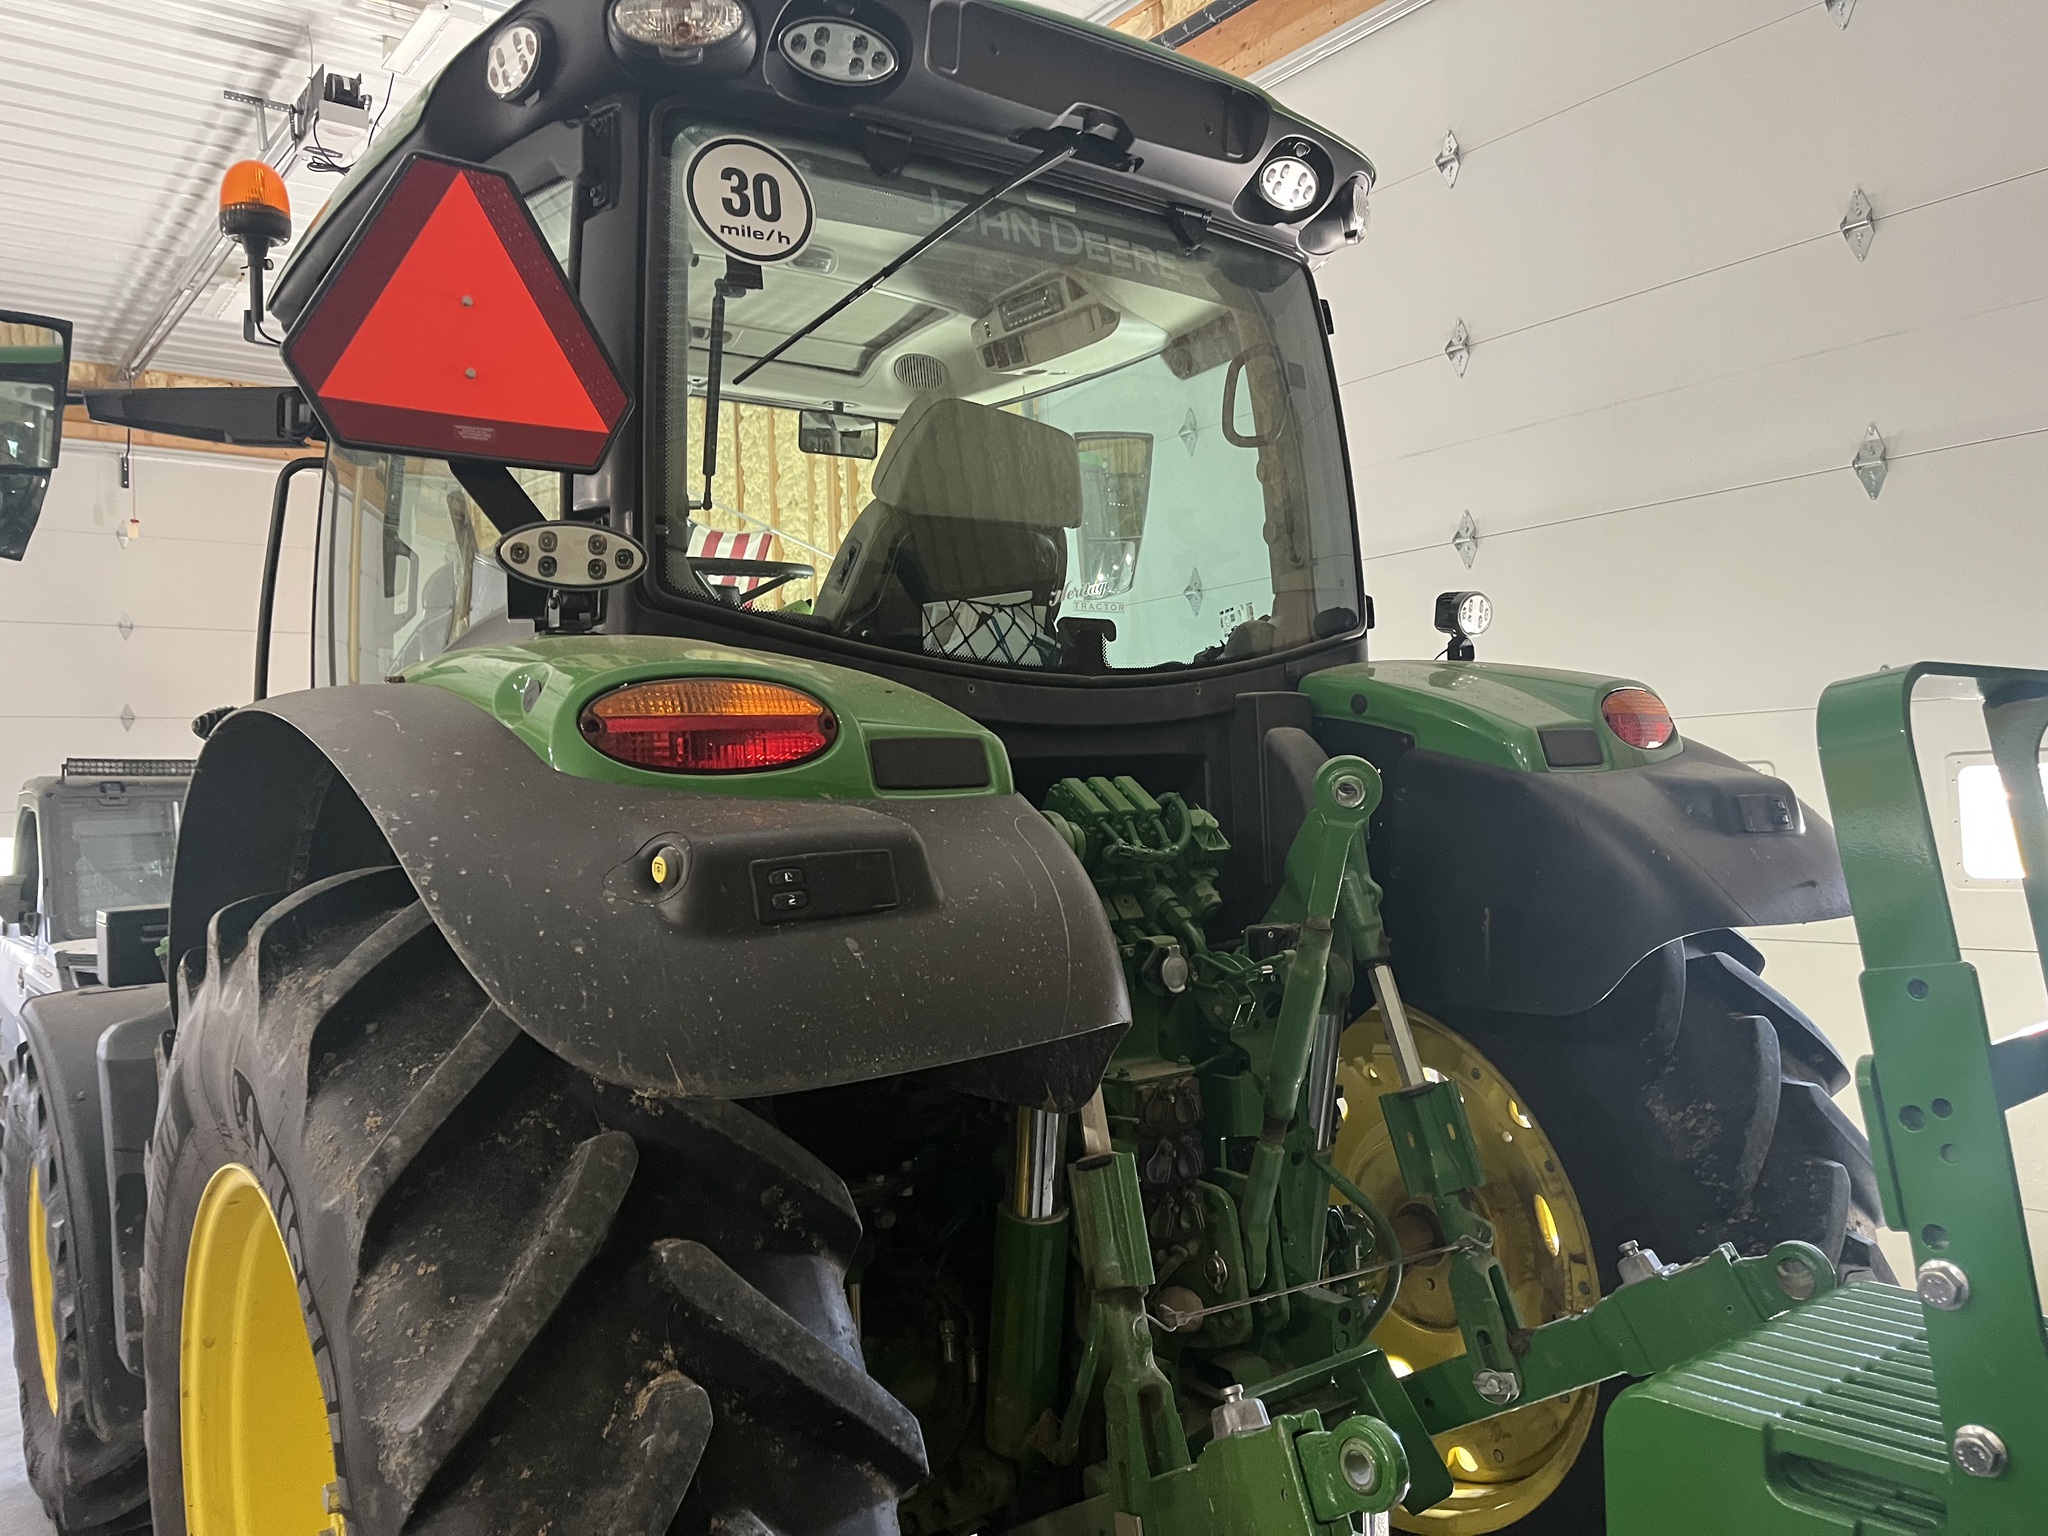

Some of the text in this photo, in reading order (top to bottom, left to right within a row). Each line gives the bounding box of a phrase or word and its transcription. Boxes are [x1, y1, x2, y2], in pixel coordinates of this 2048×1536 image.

[720, 166, 782, 223] 30
[719, 224, 791, 246] mile/h
[1049, 214, 1181, 281] DEERE
[1073, 602, 1125, 612] TRACTOR
